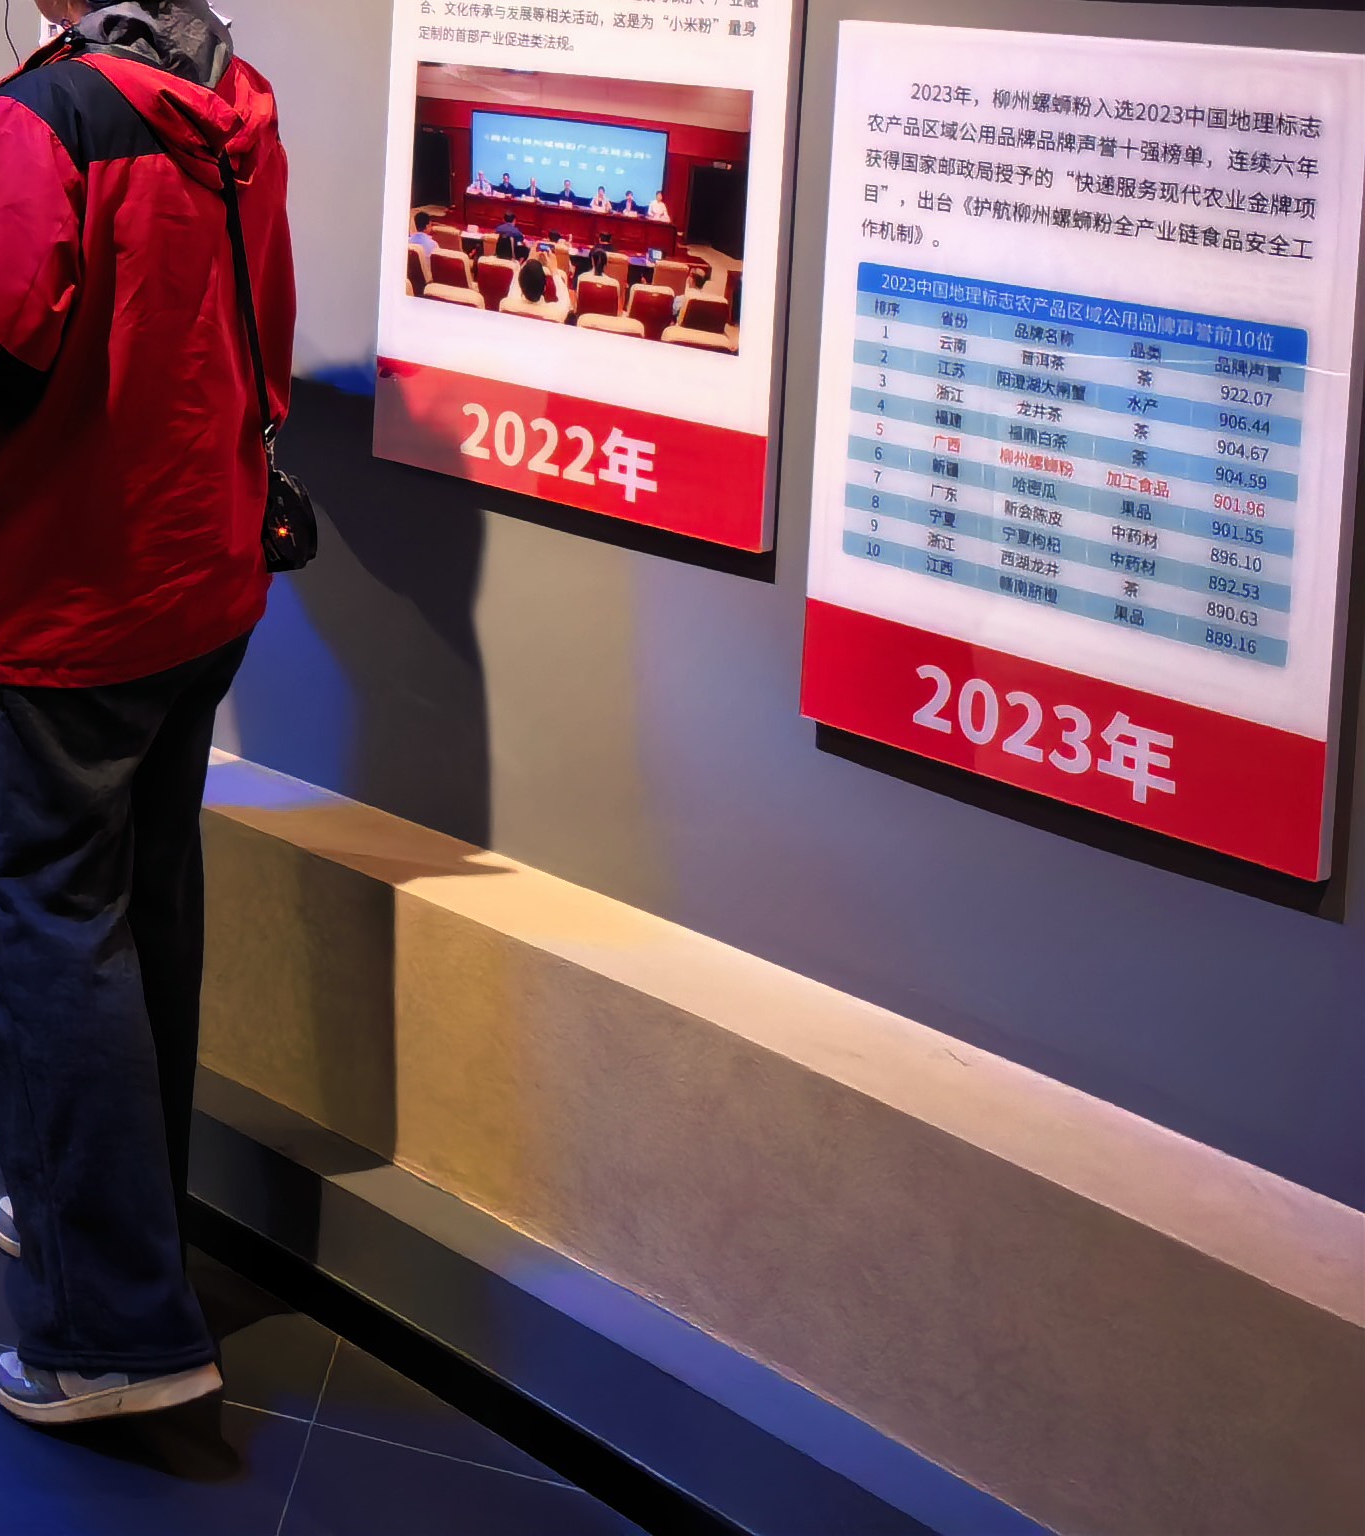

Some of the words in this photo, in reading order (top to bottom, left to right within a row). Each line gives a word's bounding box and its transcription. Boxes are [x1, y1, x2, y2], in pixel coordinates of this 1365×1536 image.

[874, 298, 900, 317] 排序
[940, 310, 968, 329] 省份
[1014, 323, 1075, 348] 品牌名称
[1130, 342, 1162, 362] 品类
[881, 273, 1275, 353] 2023中国地理标志农产品区域公用品牌声誉前10位
[880, 350, 888, 364] 2
[938, 360, 966, 379] 江苏
[1127, 395, 1159, 413] 水产
[1219, 412, 1271, 435] 906.44
[881, 325, 889, 339] 1
[940, 335, 967, 354] 云南
[1137, 369, 1154, 387] 茶
[1220, 384, 1273, 408] 922.07
[460, 400, 659, 503] 2022年
[877, 398, 885, 412] 4
[1131, 449, 1148, 467] 茶
[1215, 466, 1267, 490] 904.59
[879, 374, 887, 388] 3
[936, 383, 964, 404] 浙江
[1133, 423, 1150, 441] 茶
[1217, 439, 1270, 463] 904.67
[874, 446, 883, 460] 6
[1121, 499, 1152, 521] 果品
[1212, 520, 1264, 545] 901.55
[875, 422, 884, 436] 5
[933, 435, 961, 453] 广西
[1106, 470, 1171, 499] 加工食品
[1213, 493, 1266, 518] 901.96
[871, 494, 880, 508] 8
[929, 509, 956, 529] 宁夏
[1110, 551, 1155, 576] 中药材
[1208, 576, 1260, 600] 892.53
[874, 470, 882, 484] 7
[931, 483, 958, 503] 广东
[1112, 525, 1158, 550] 中药材
[1210, 548, 1262, 573] 896.10
[866, 541, 881, 557] 10
[926, 555, 953, 576] 江西
[1114, 604, 1145, 627] 果品
[1205, 628, 1257, 654] 889.16
[870, 518, 878, 532] 9
[927, 531, 955, 553] 浙江
[1122, 580, 1139, 599] 茶
[1207, 601, 1259, 627] 890.63
[911, 663, 1179, 805] 2023年
